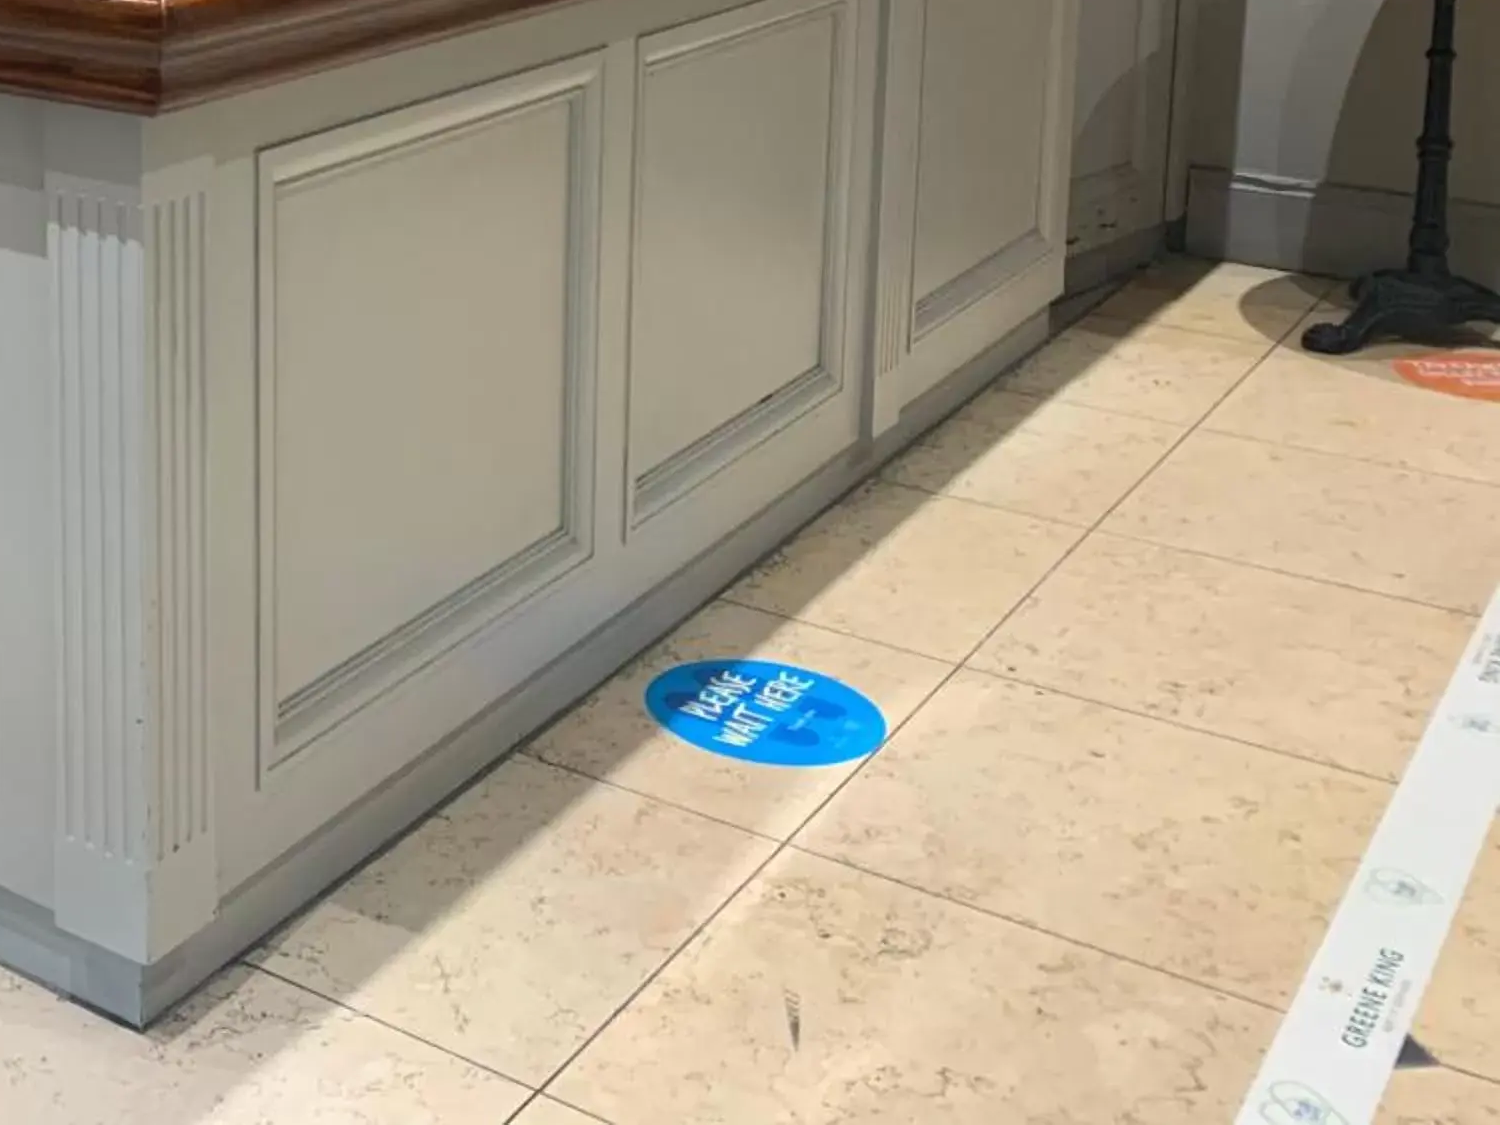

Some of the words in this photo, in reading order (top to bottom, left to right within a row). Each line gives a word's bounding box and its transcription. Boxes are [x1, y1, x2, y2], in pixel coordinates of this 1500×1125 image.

[678, 670, 757, 721] PLEASE
[712, 702, 774, 747] WAIT
[754, 671, 815, 713] HERE
[1340, 986, 1388, 1050] GREENE
[1364, 946, 1405, 989] KING
